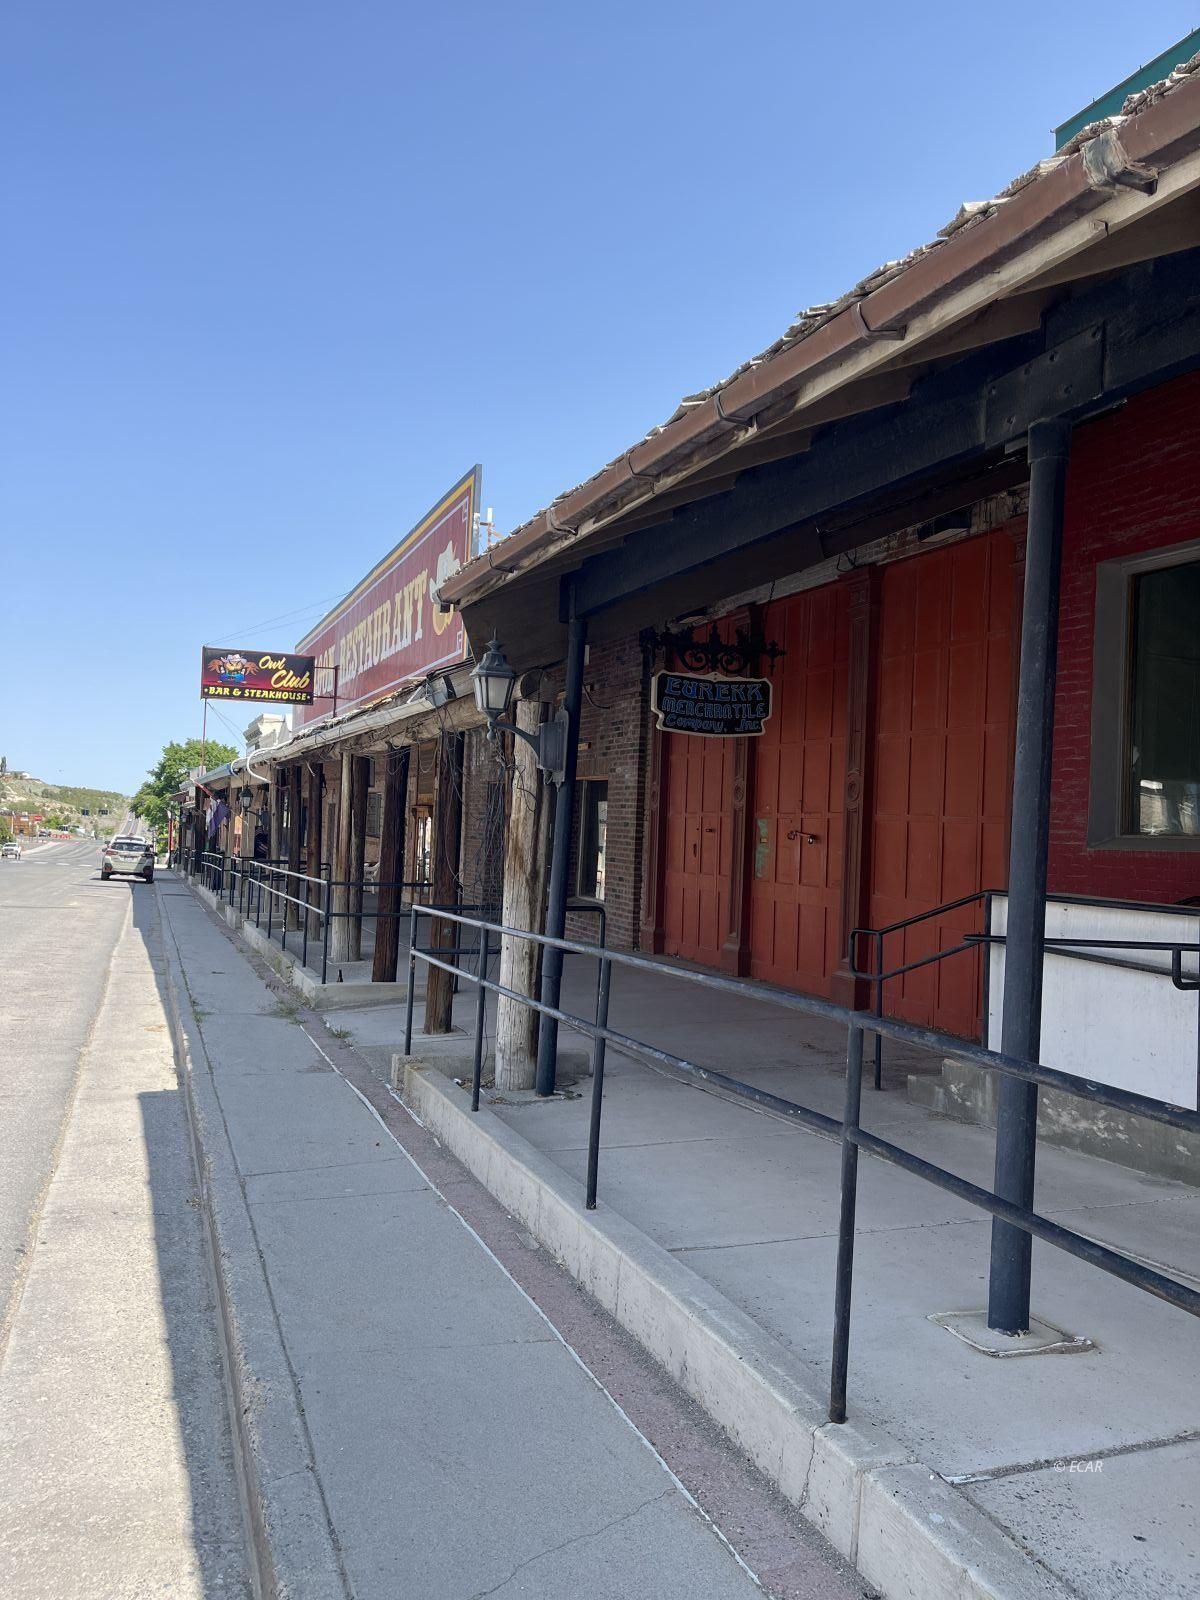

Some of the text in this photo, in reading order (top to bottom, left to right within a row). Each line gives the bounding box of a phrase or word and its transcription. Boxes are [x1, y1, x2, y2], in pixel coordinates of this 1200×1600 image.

[339, 568, 428, 686] RESTAURANT
[258, 655, 287, 670] Owl
[270, 669, 311, 689] Club
[208, 686, 307, 701] BAR & STEAKHOUSE
